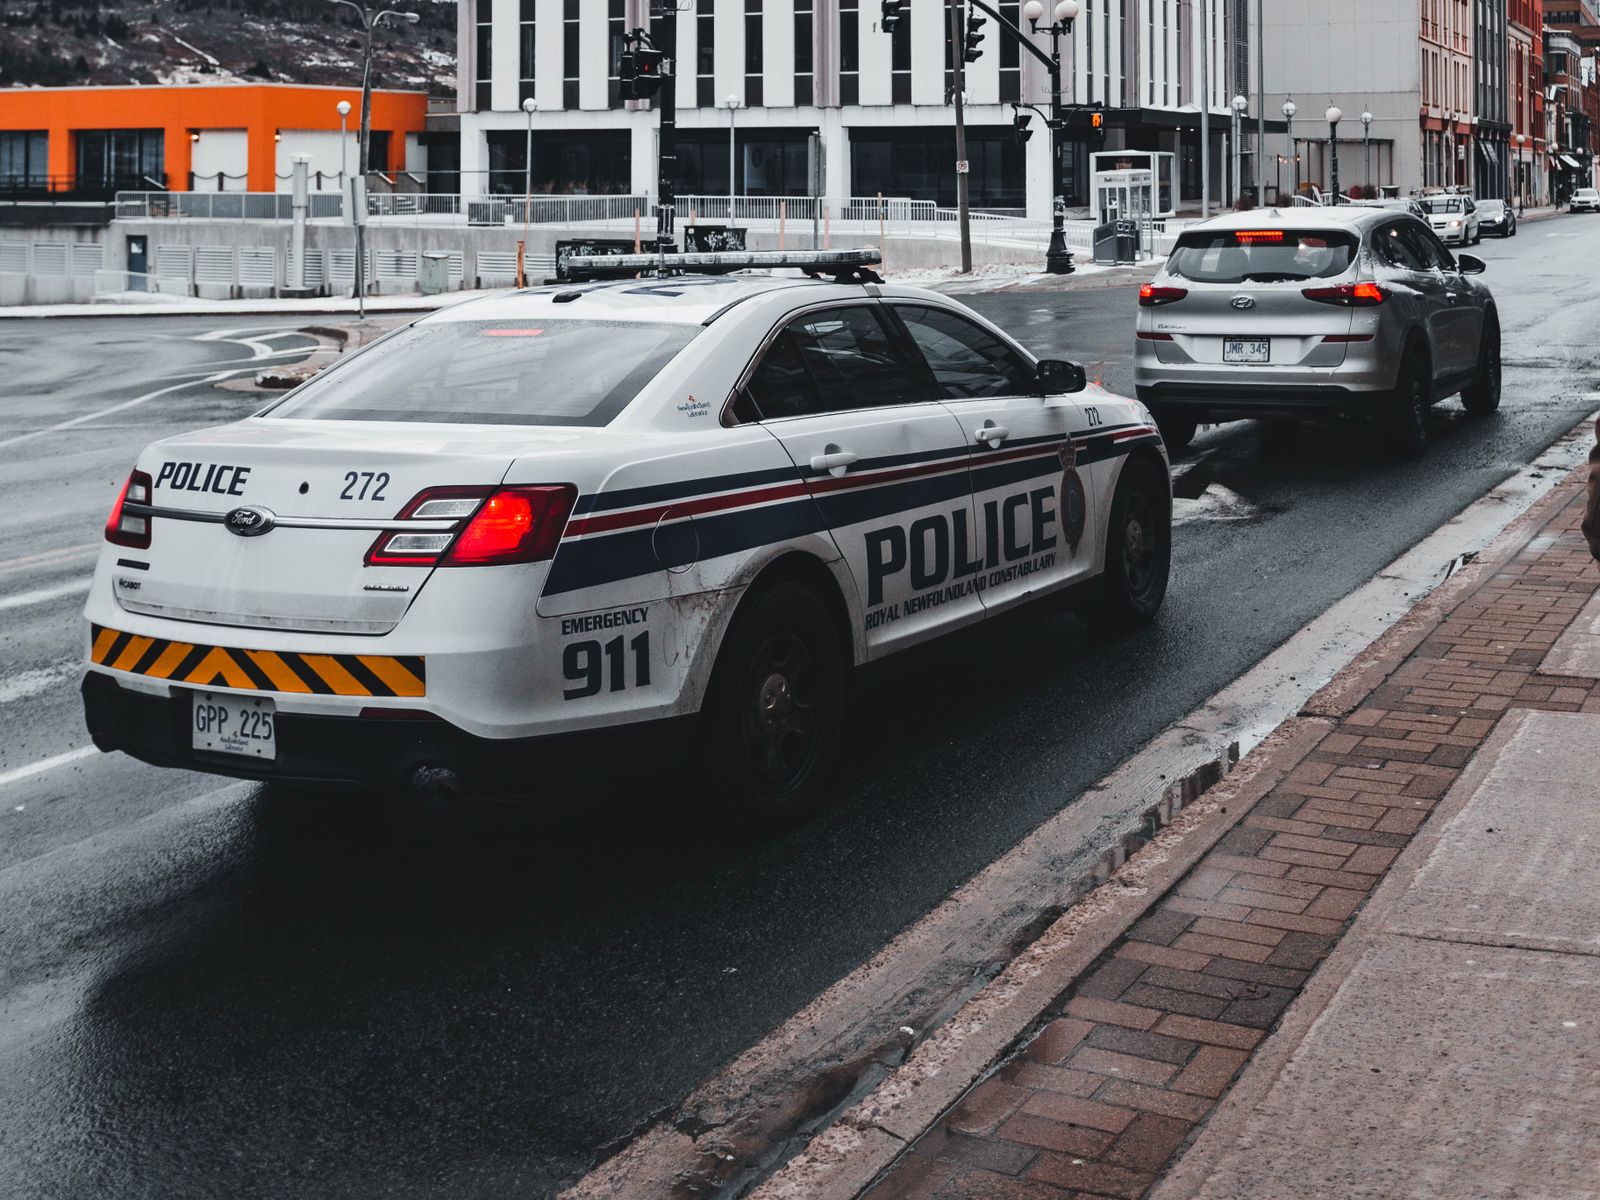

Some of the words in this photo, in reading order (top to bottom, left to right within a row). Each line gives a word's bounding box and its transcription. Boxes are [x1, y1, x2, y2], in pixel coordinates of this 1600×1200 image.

[1225, 342, 1244, 354] JMR
[1250, 343, 1268, 354] 345
[1084, 406, 1103, 427] 272
[154, 461, 251, 496] POLICE
[340, 471, 390, 501] 272
[232, 510, 256, 524] Ford
[864, 485, 1056, 608] POLICE
[865, 607, 901, 631] ROYAL
[904, 575, 987, 617] NEWFOUNDLAND
[989, 552, 1056, 587] CONSTABULARY
[562, 607, 649, 635] EMERGENCY
[563, 630, 651, 701] 911
[196, 704, 228, 734] GPP
[240, 709, 272, 740] 225
